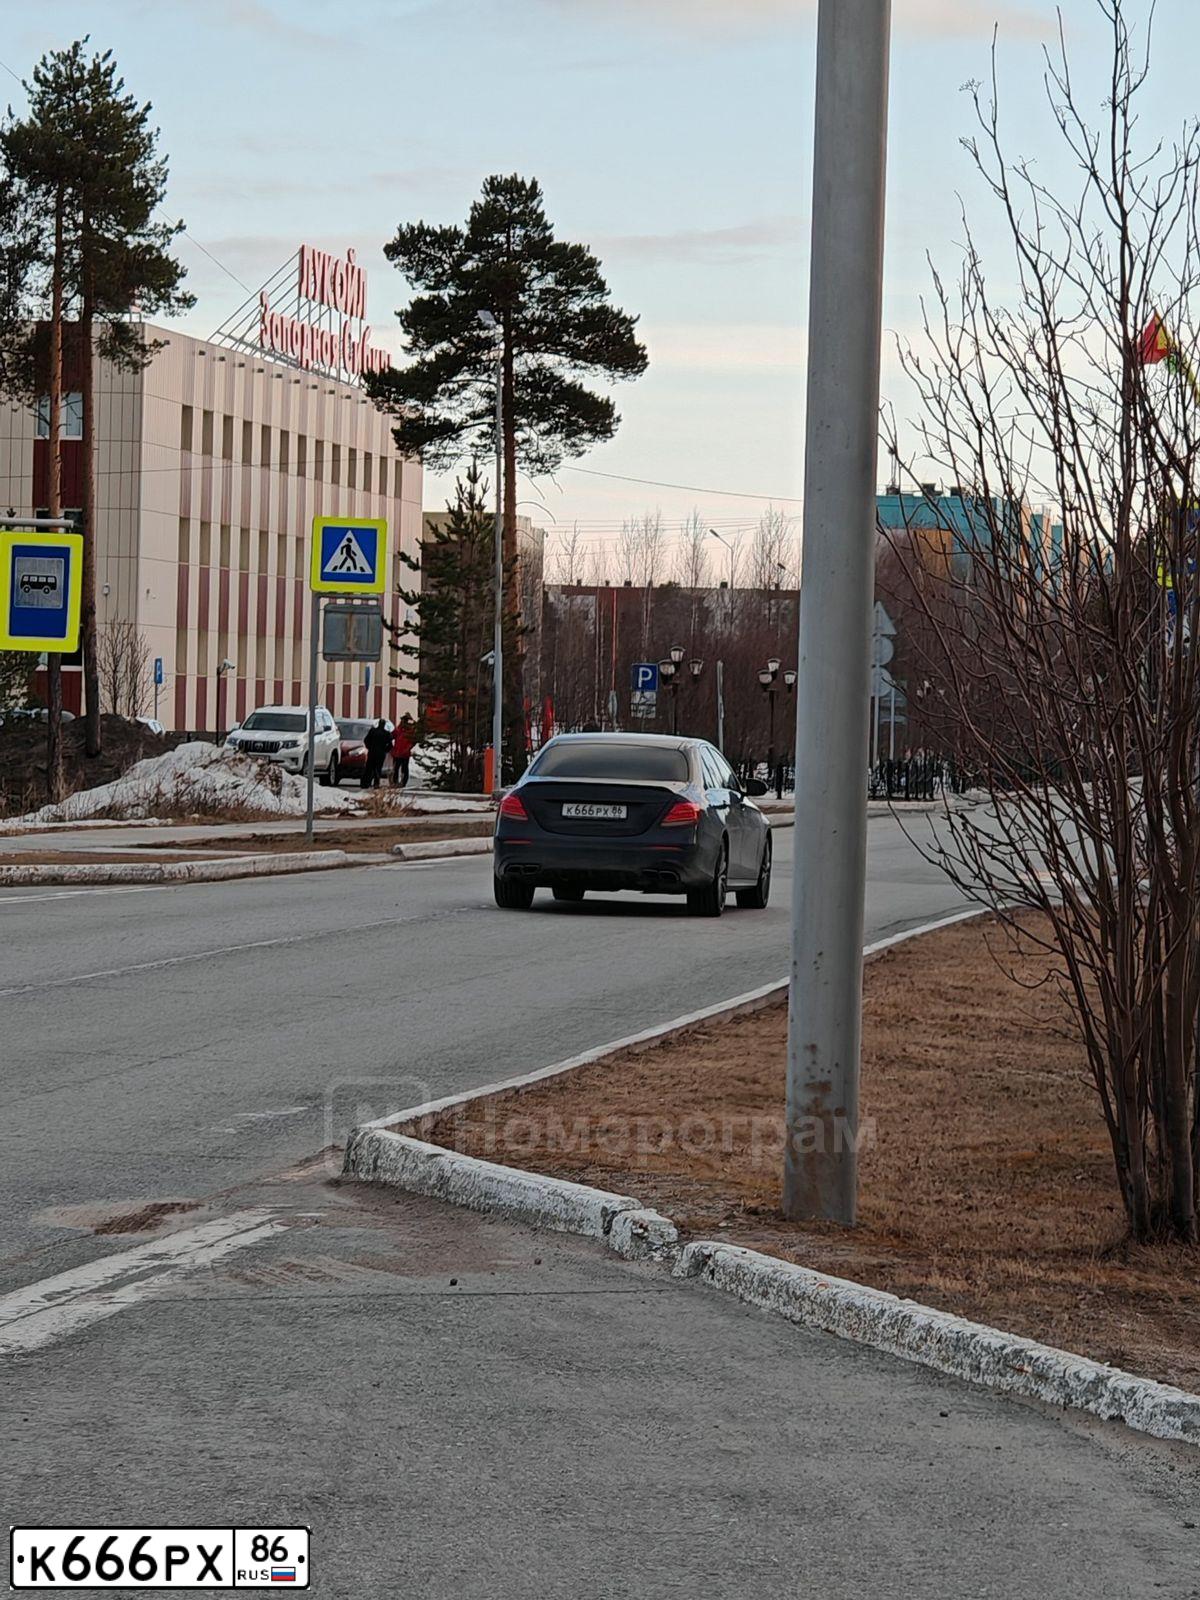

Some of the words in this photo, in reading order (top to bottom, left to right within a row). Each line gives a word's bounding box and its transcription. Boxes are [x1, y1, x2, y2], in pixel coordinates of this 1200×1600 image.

[299, 244, 367, 320] ЛУКОЙЛ
[260, 291, 339, 370] Западная
[638, 667, 652, 688] P
